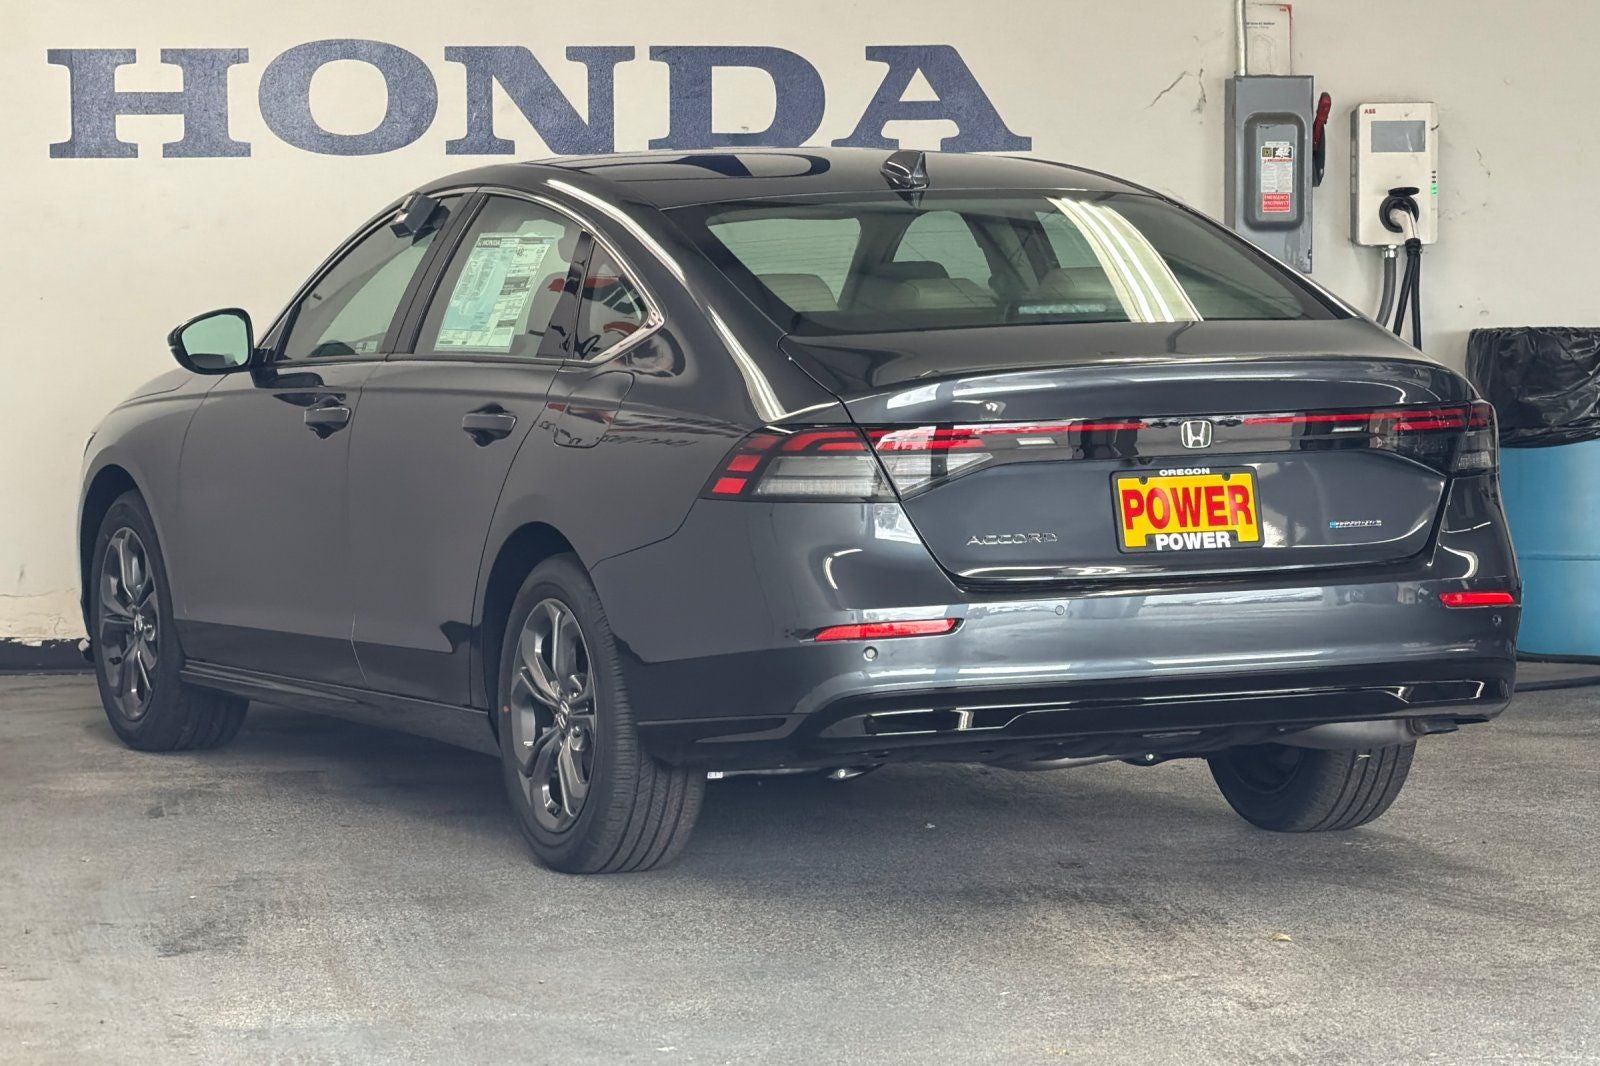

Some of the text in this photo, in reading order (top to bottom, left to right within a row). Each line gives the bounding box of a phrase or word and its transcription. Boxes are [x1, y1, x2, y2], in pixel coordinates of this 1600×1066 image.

[47, 38, 1032, 157] HONDA
[1159, 467, 1210, 476] OREGON
[1121, 484, 1253, 530] POWER
[966, 532, 1058, 546] ACCORD
[1155, 531, 1231, 551] POWER
